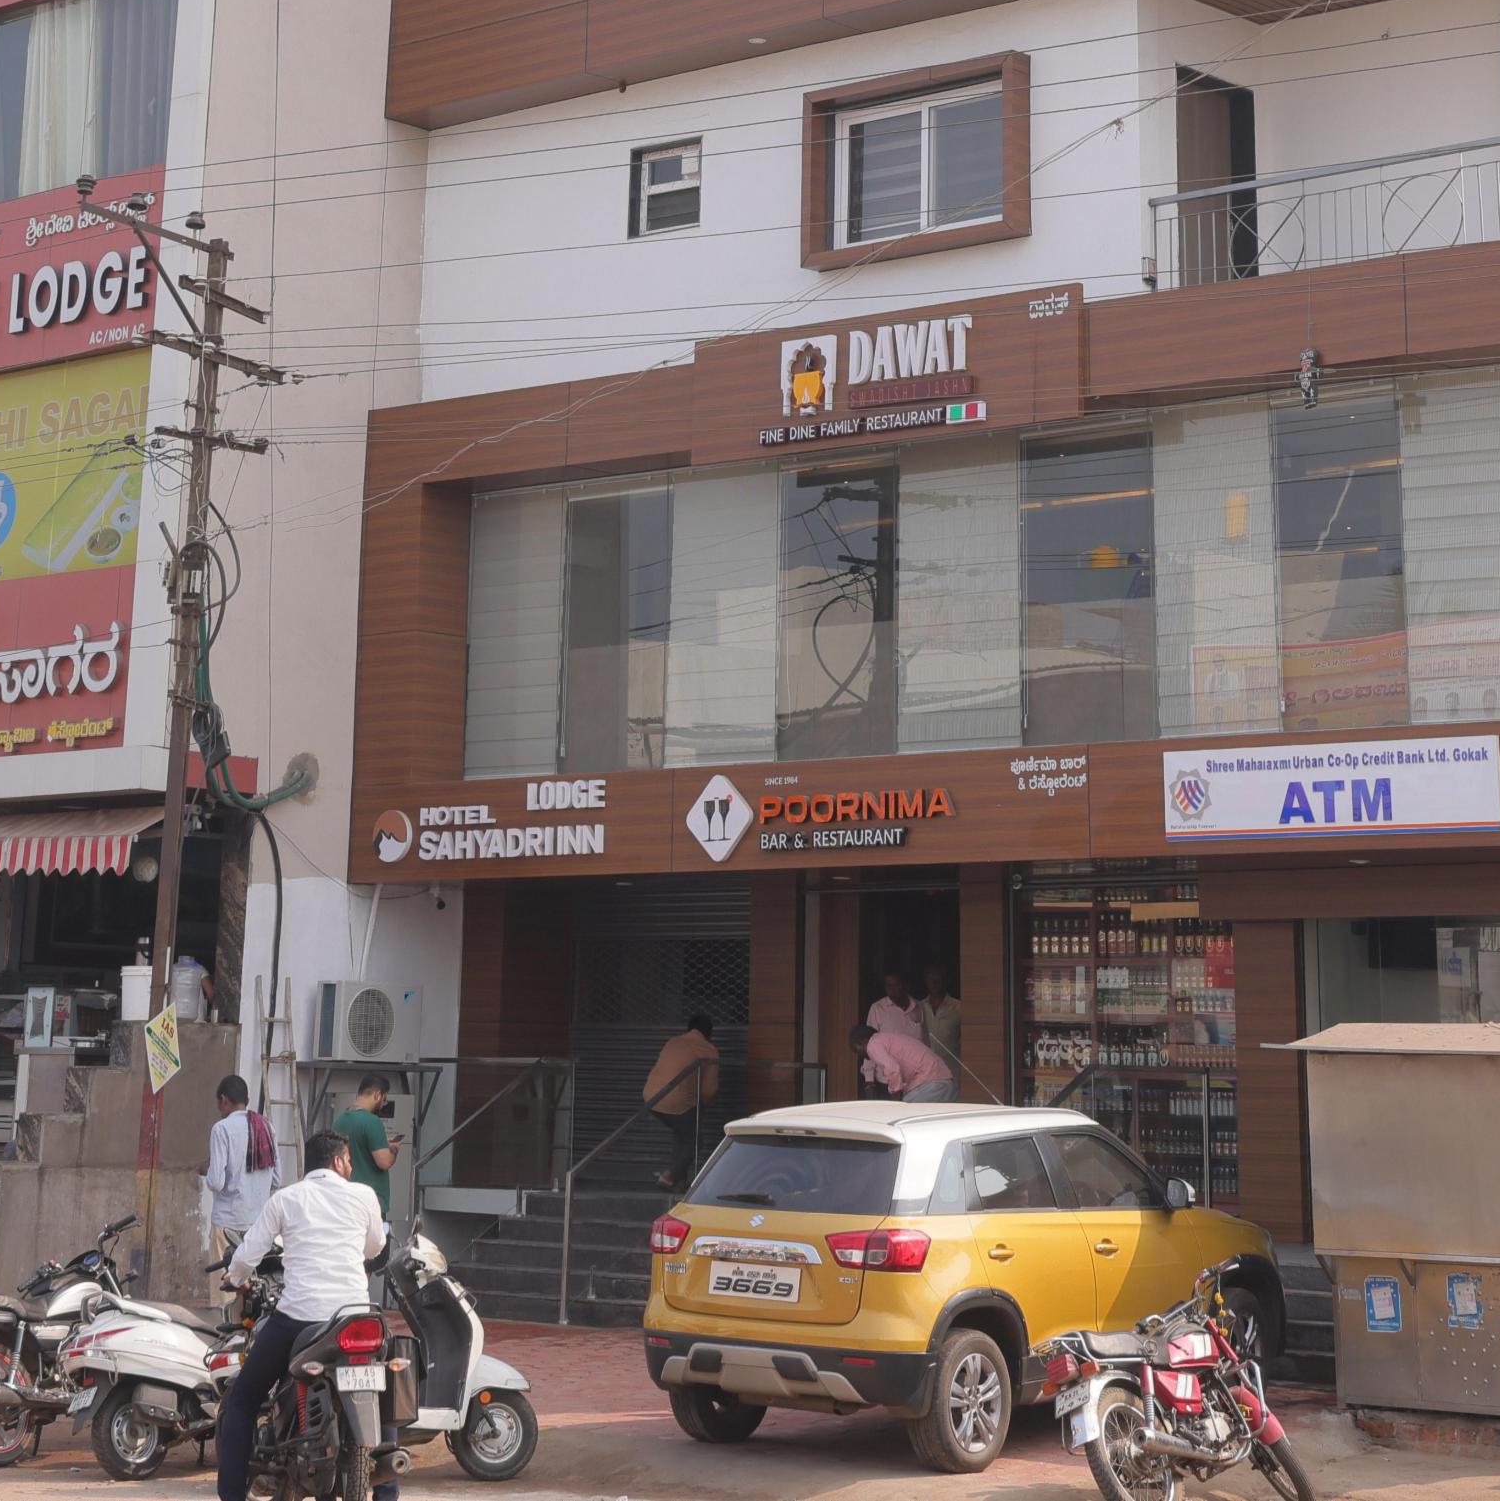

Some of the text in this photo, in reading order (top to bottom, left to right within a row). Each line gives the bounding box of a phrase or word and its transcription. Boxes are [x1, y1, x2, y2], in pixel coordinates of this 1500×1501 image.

[8, 244, 152, 335] LODGE
[848, 313, 973, 386] DAWAT
[759, 407, 944, 445] FINE DINE FAMILY RESTAURANT
[1060, 755, 1087, 769] ಬಾರ್
[1206, 757, 1235, 774] Shree
[1293, 752, 1324, 768] Urban
[1328, 749, 1359, 769] Co-Op
[1362, 748, 1396, 766] Credit
[1398, 748, 1426, 765] Bank
[1428, 747, 1450, 763] Ltd.
[1453, 746, 1489, 762] Gokak
[764, 776, 784, 786] SINCE
[1018, 779, 1026, 790] &
[526, 779, 607, 812] LODGE
[758, 787, 955, 826] POORNIMA
[1278, 777, 1394, 825] ATM
[418, 804, 497, 827] HOTEL
[759, 828, 905, 851] BAR & RESTAURANT
[713, 1276, 794, 1297] 3669
[343, 1366, 358, 1378] KA
